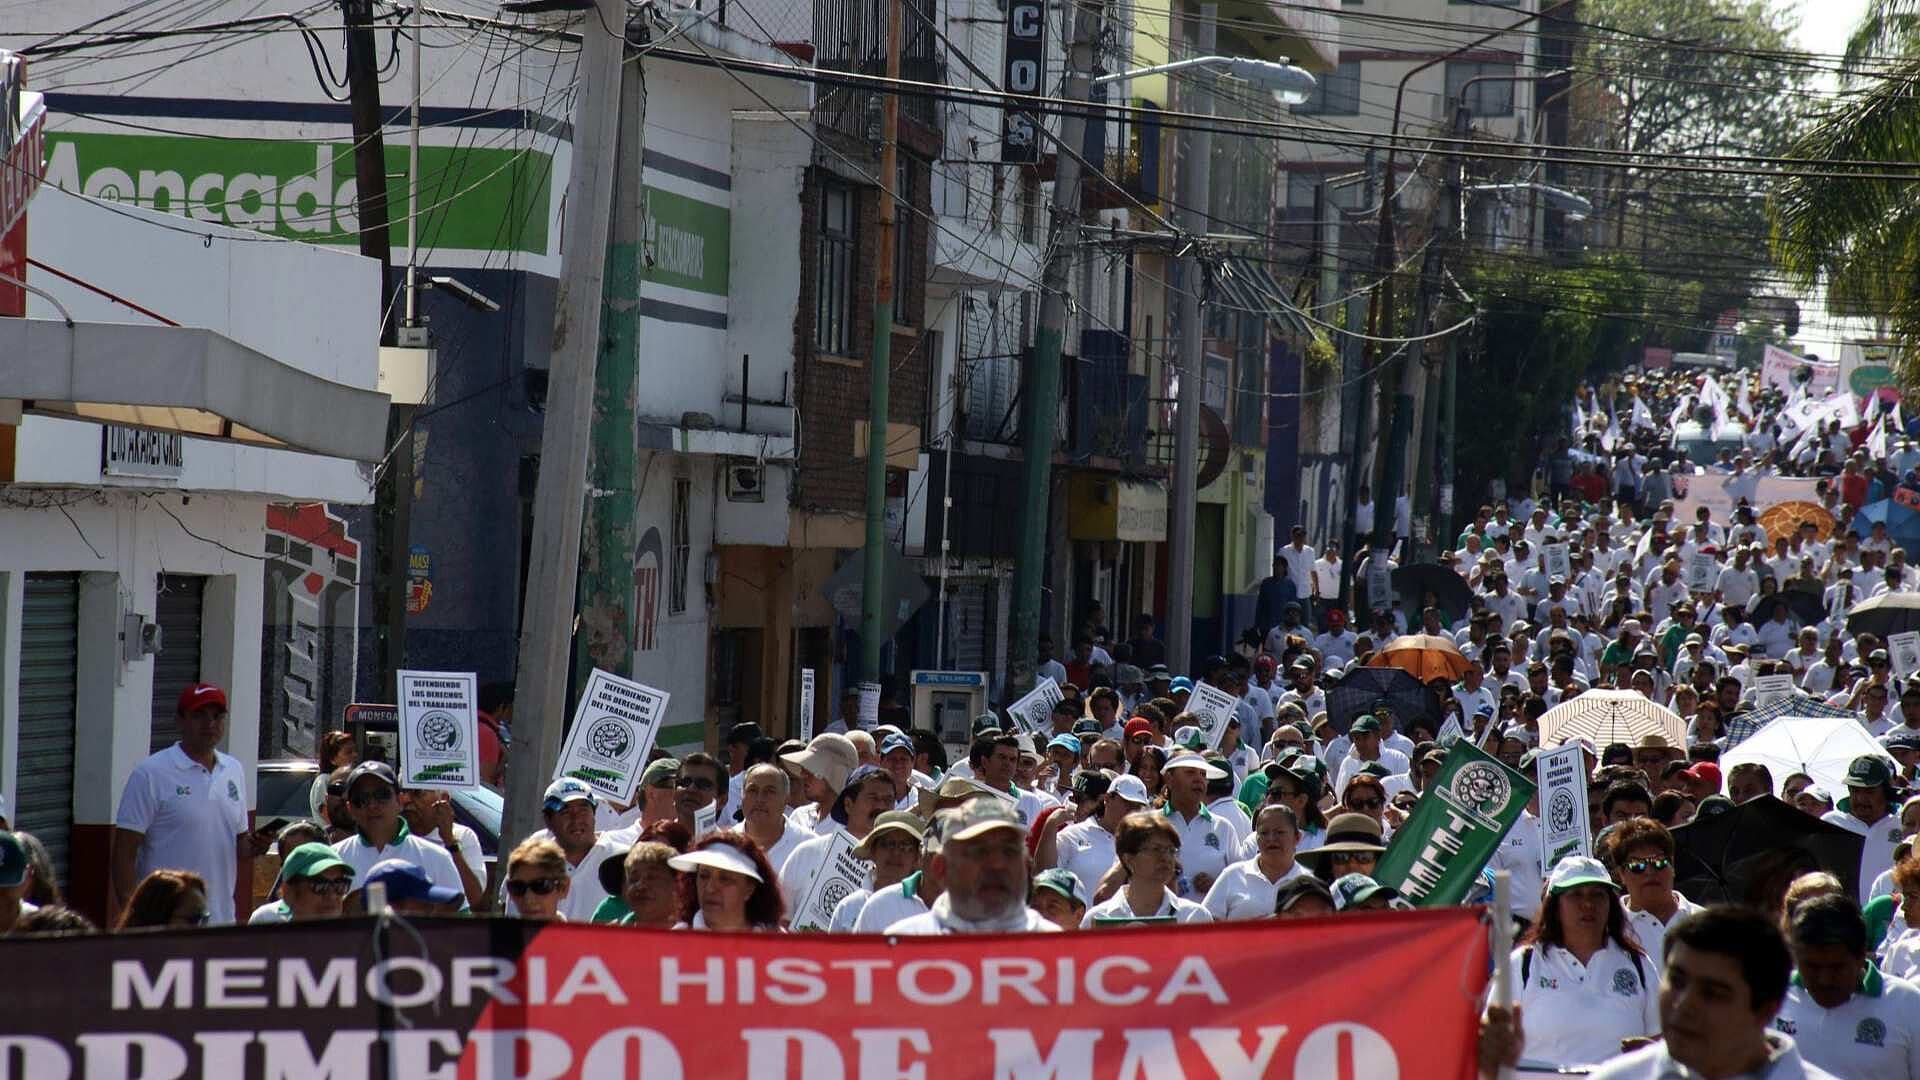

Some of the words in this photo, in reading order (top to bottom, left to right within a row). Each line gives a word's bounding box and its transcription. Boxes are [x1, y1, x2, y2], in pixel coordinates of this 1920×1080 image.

[413, 680, 461, 689] DEFENDIENDO
[411, 690, 425, 698] LOS
[426, 690, 464, 699] DERECHOS
[604, 683, 652, 704] DEFENDIENDO
[408, 700, 421, 708] DEL
[422, 700, 468, 710] TRABAJADOR
[598, 692, 612, 702] LOS
[612, 695, 650, 715] DERECHOS
[591, 699, 604, 710] DEL
[605, 705, 651, 726] TRABAJADOR
[1550, 756, 1559, 768] NO
[111, 956, 628, 1009] MEMORIA
[659, 956, 1230, 1005] HISTORICA
